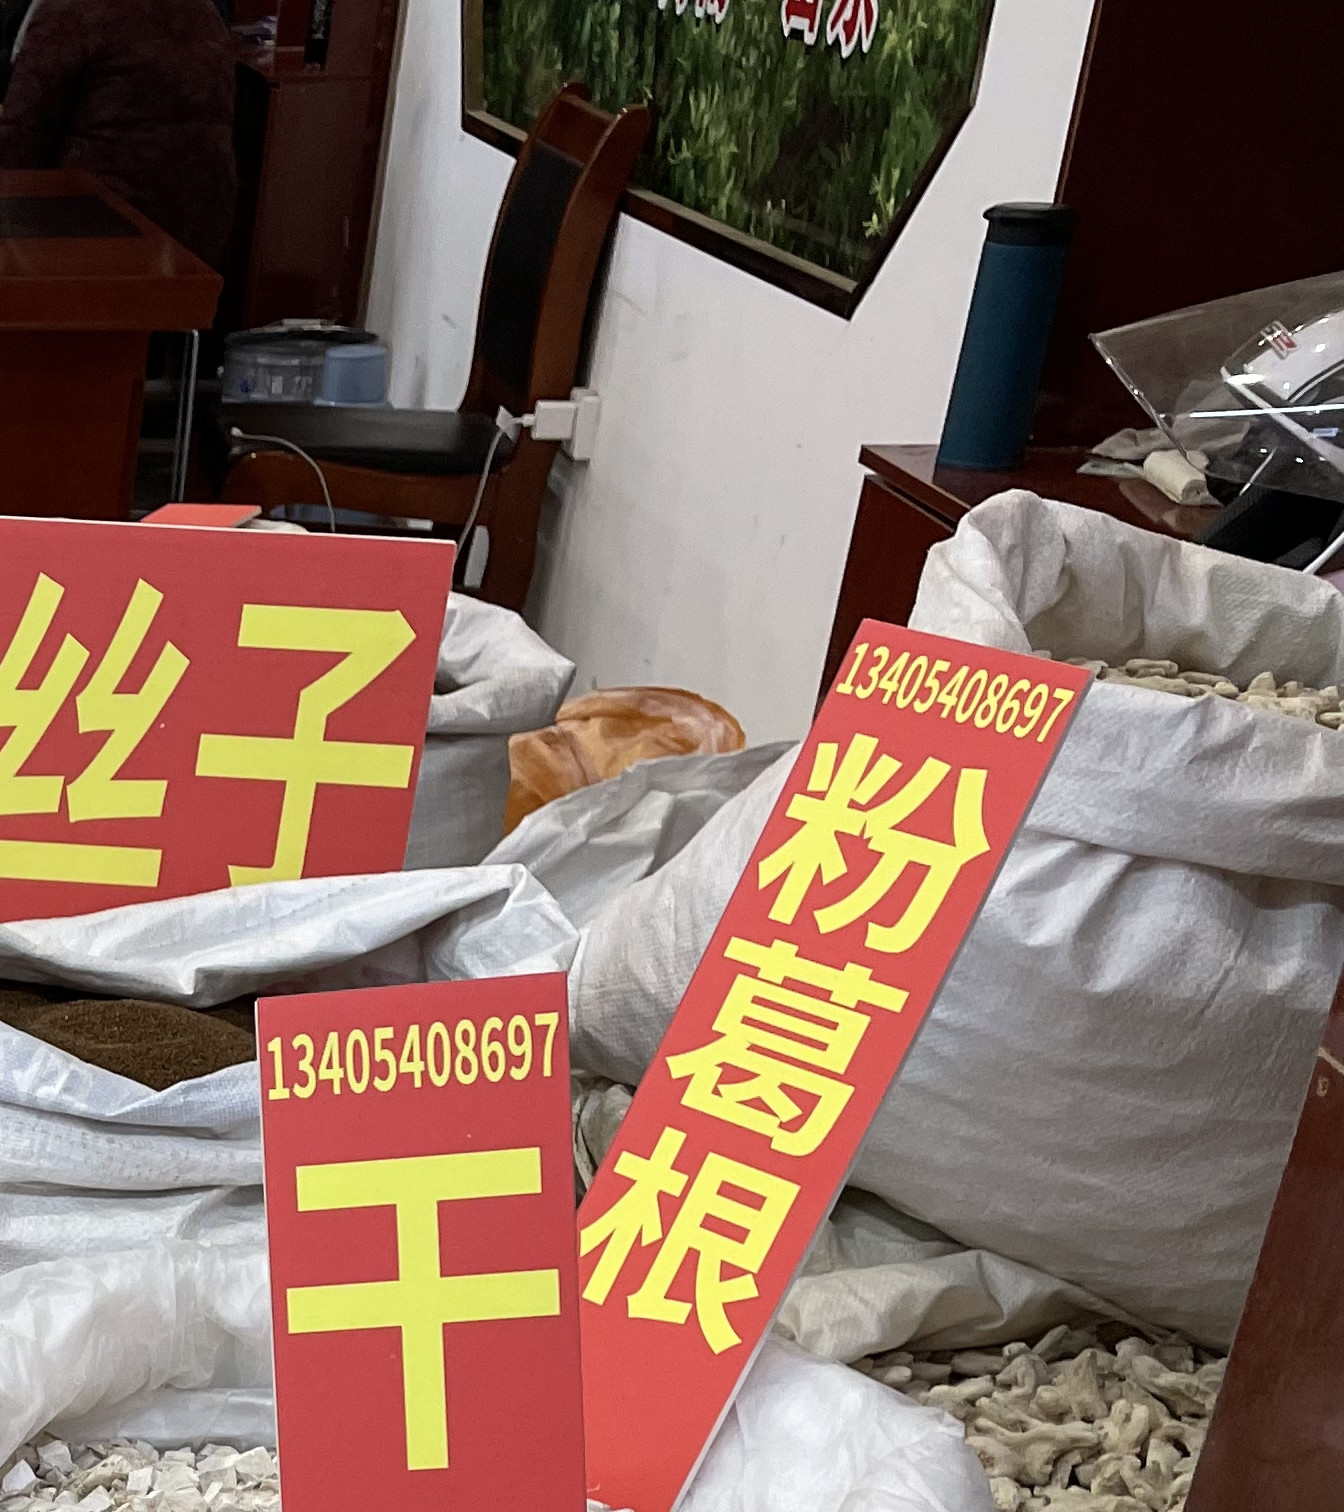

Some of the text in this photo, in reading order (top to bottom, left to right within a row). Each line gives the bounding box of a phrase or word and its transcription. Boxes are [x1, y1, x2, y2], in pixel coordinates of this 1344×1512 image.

[836, 644, 1074, 742] 13405408697
[268, 1013, 558, 1100] 13405408697
[580, 734, 987, 1354] 粉葛根
